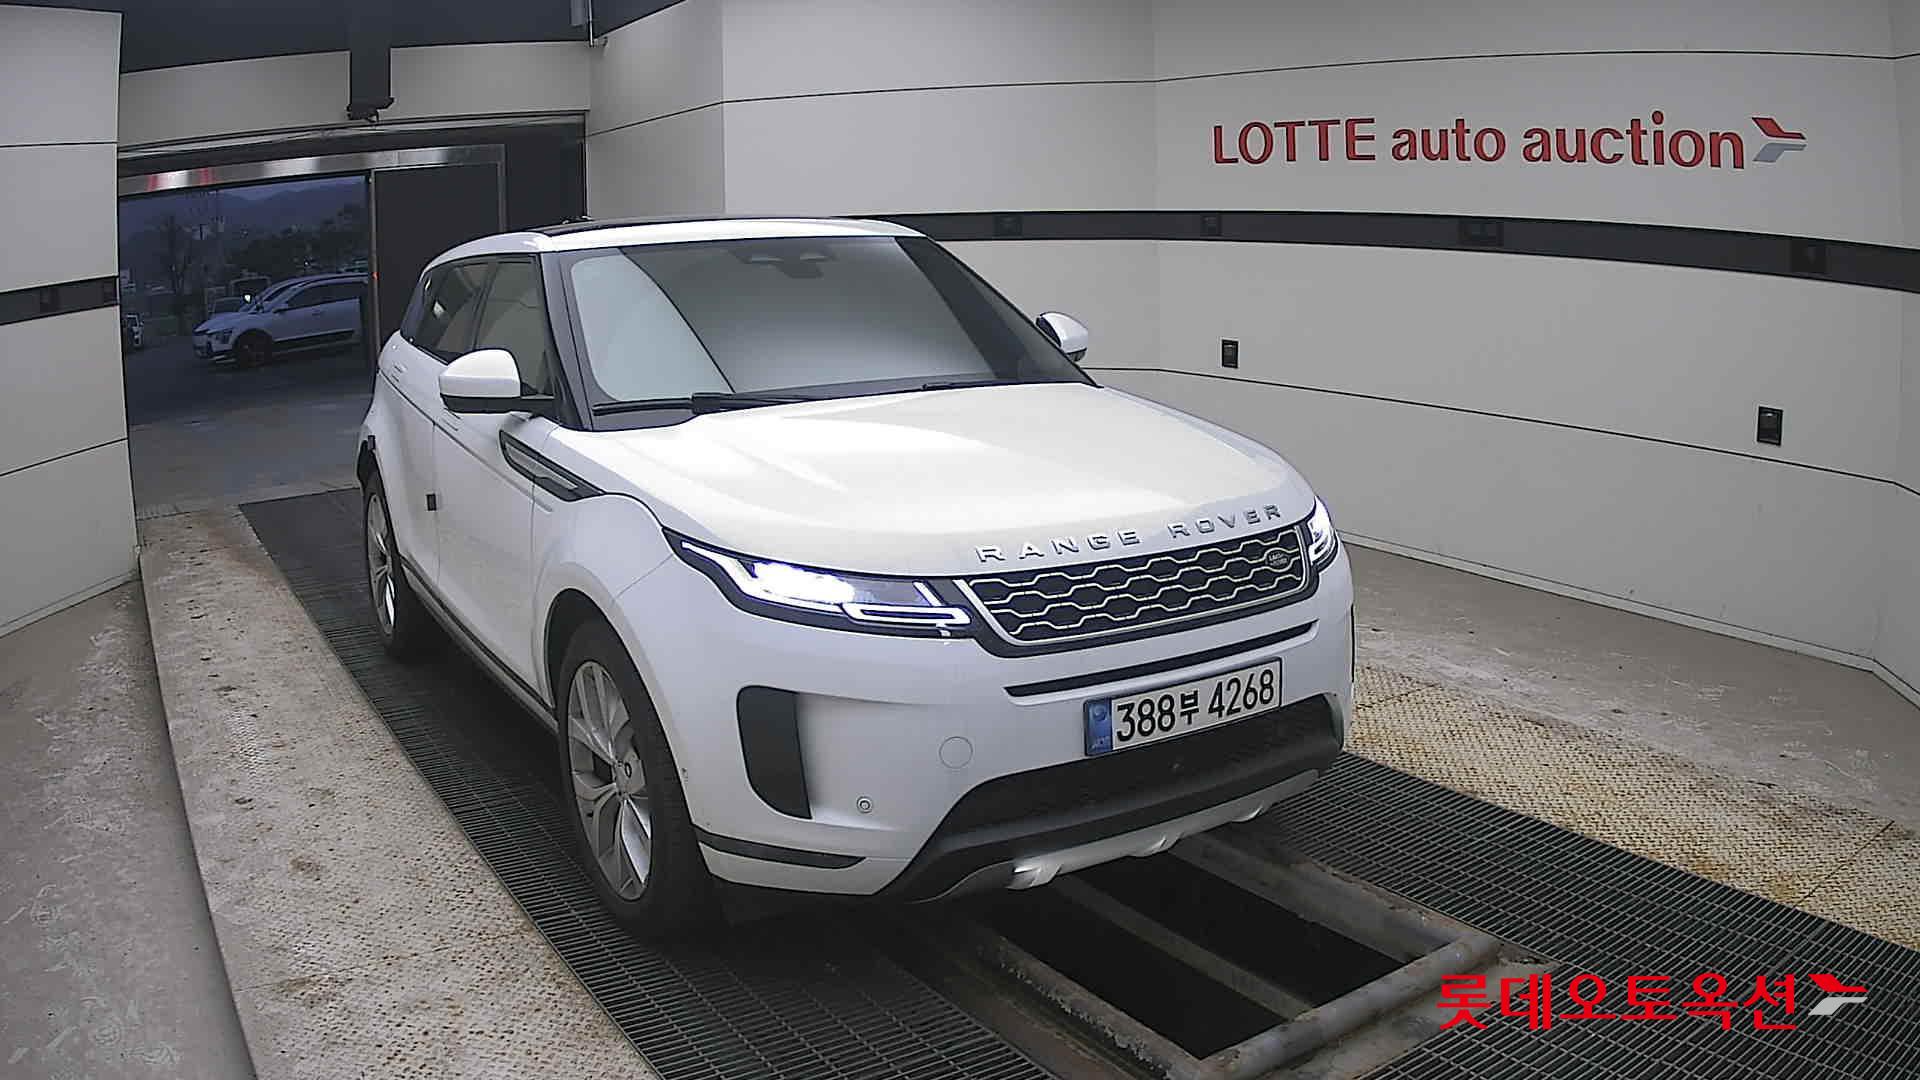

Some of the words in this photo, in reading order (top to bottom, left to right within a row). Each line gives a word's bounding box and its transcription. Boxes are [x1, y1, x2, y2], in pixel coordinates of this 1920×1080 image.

[1213, 117, 1376, 164] LOTTE
[1391, 117, 1507, 162] auto
[1522, 110, 1745, 169] auction
[975, 527, 1141, 564] RANGE
[1167, 504, 1282, 540] ROVER
[1116, 690, 1200, 743] 388부
[1208, 669, 1275, 721] 4268
